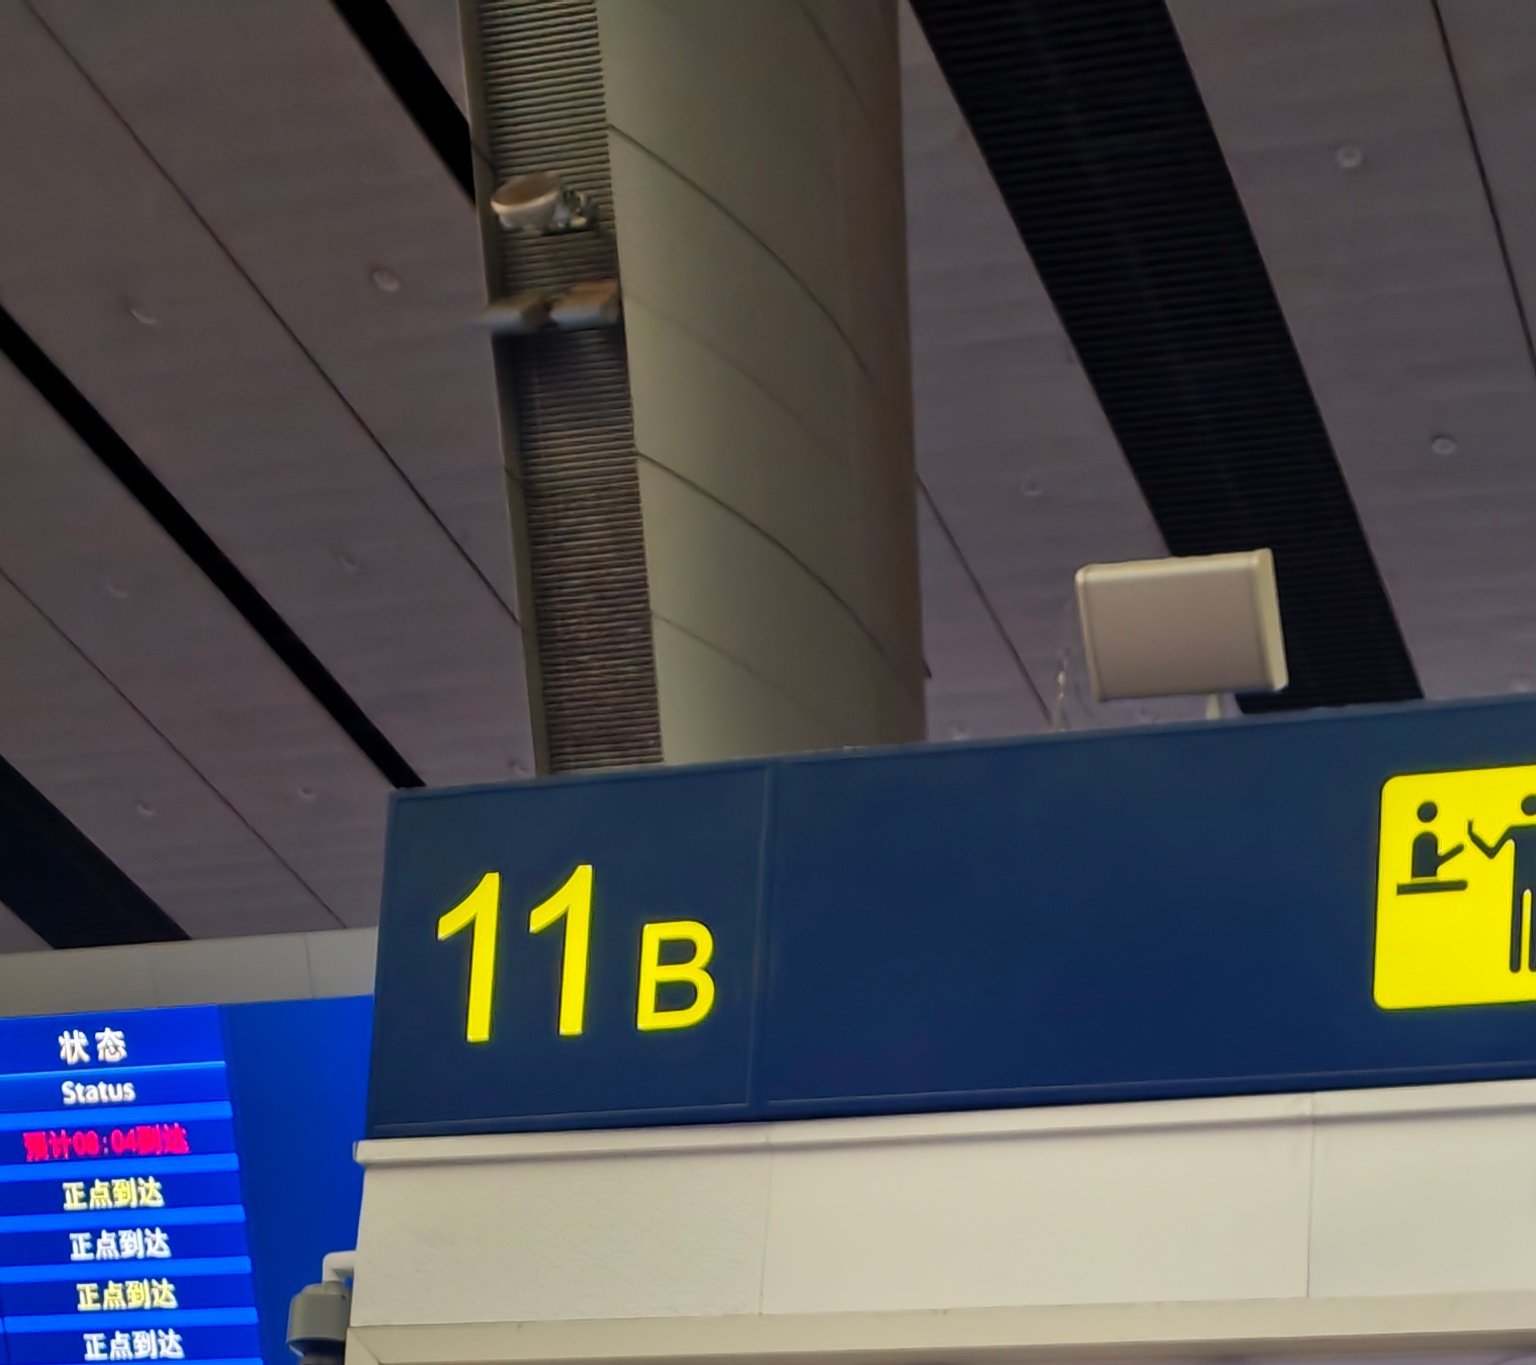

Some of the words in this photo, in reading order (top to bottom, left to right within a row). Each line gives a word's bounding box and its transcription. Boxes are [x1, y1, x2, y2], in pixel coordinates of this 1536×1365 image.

[58, 1027, 127, 1065] 状态
[61, 1081, 136, 1104] Status
[63, 1176, 165, 1210] 正点到达
[70, 1226, 171, 1261] 正点到达
[76, 1277, 178, 1312] 正点到达
[83, 1328, 185, 1362] 正点到达
